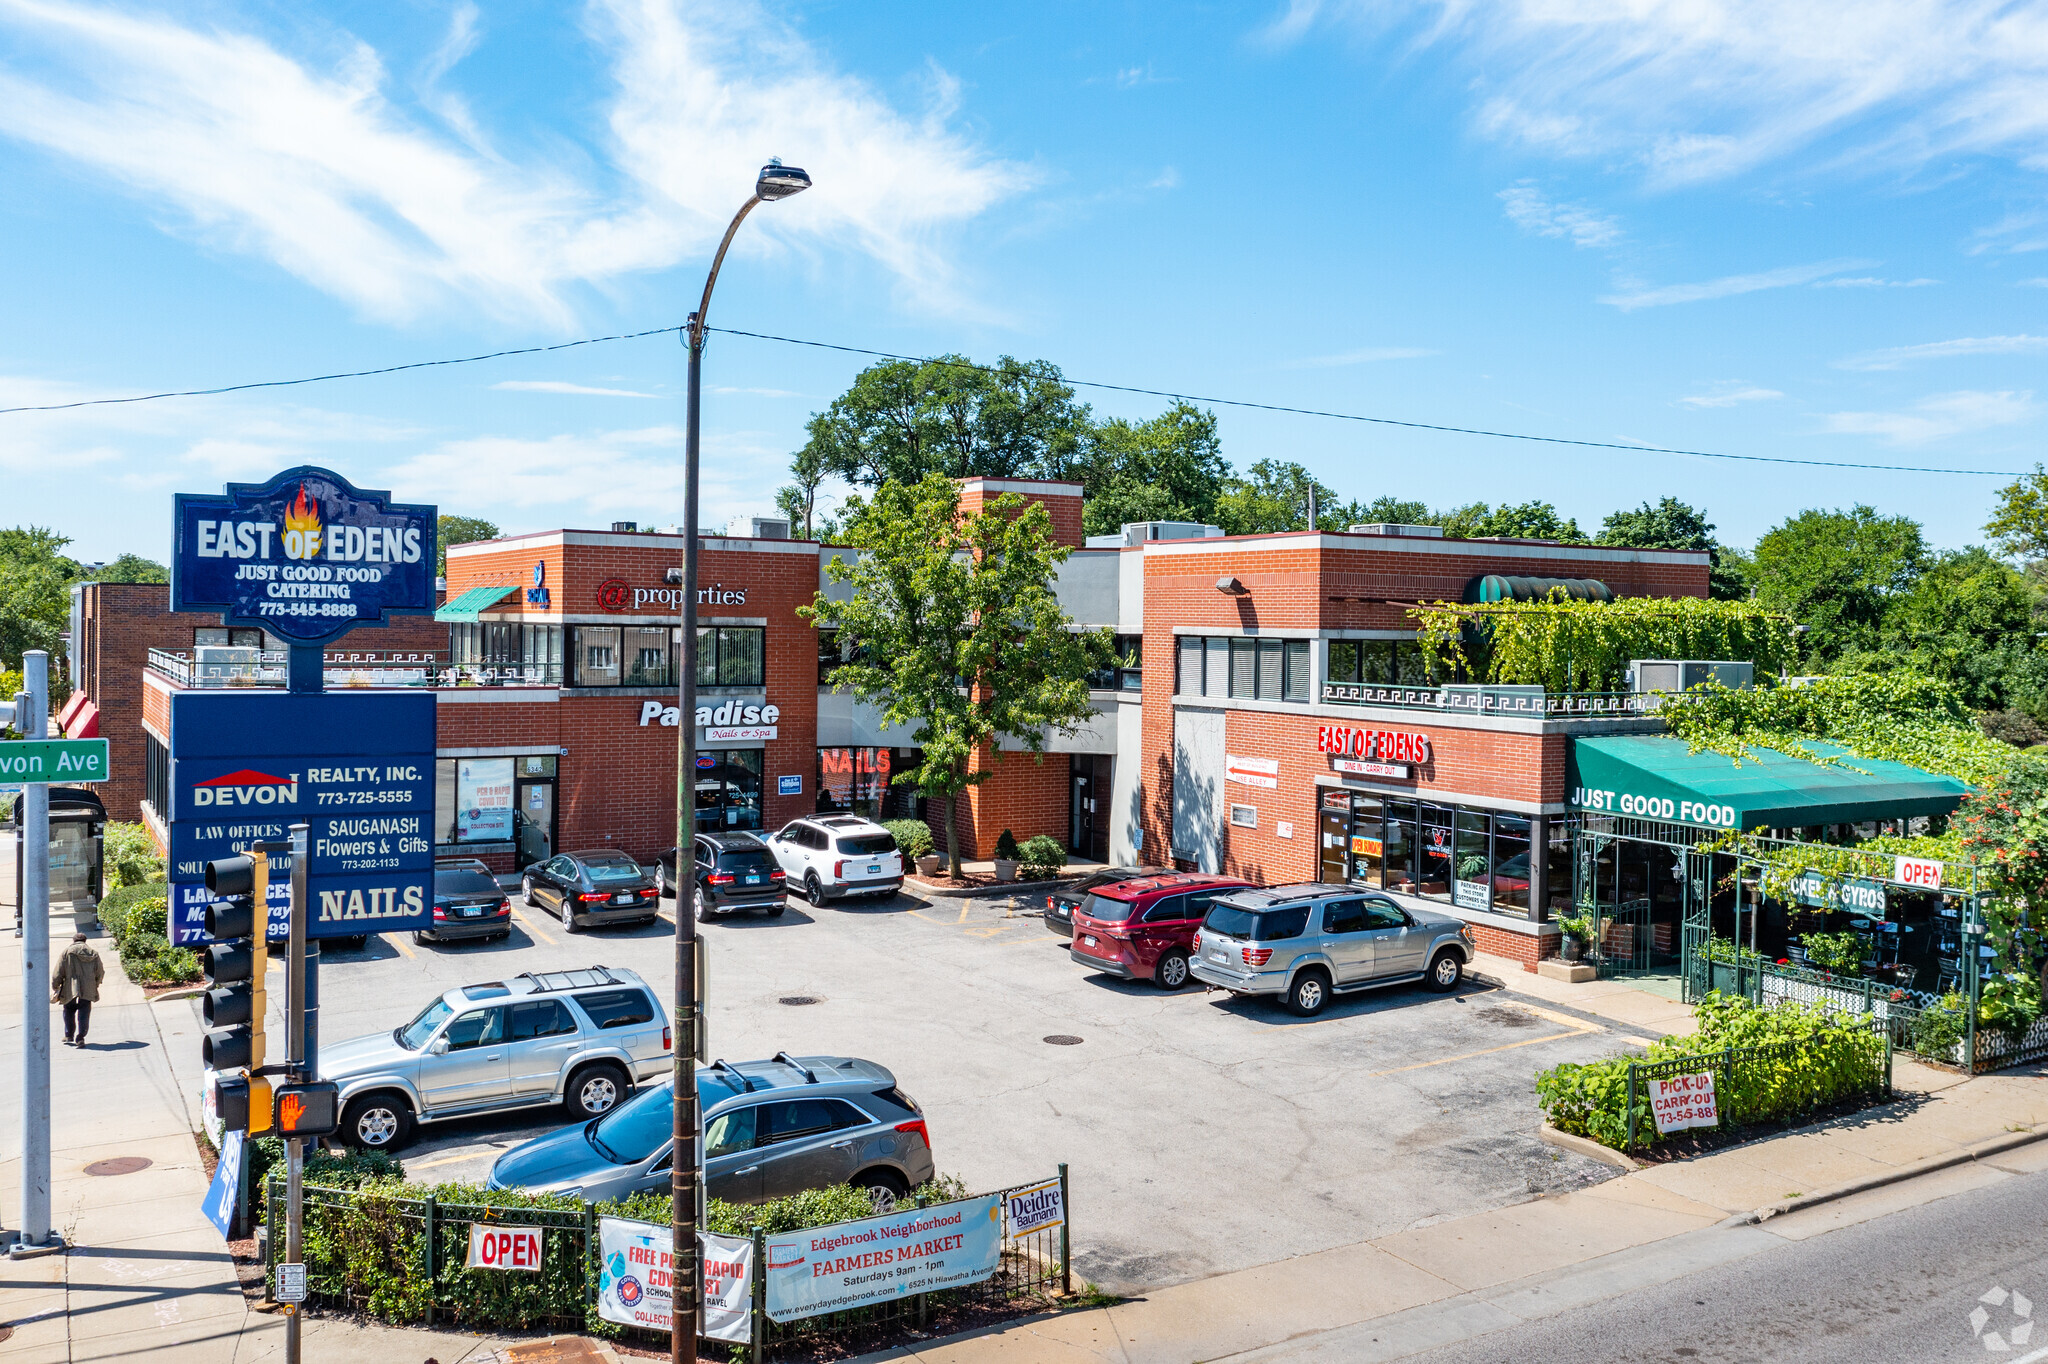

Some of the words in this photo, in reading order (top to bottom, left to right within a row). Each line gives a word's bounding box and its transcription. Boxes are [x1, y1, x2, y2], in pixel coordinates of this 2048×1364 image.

[198, 520, 276, 558] EAST
[284, 530, 319, 560] OF
[328, 525, 421, 563] EDENS
[235, 565, 278, 580] JUST
[282, 566, 331, 582] GOOD
[337, 567, 381, 583] FOOD
[267, 584, 350, 599] CATERING
[597, 579, 748, 612] @proprties
[260, 602, 357, 616] 773-545-8888
[639, 700, 780, 727] Paadise
[712, 730, 738, 739] Nails
[741, 729, 751, 737] &
[752, 729, 771, 739] Spa
[1318, 727, 1351, 754] EAST
[1355, 730, 1373, 757] OF
[1377, 731, 1424, 763] EDENS
[0, 755, 42, 773] von
[56, 751, 99, 771] Ave
[823, 750, 891, 773] NAILS
[1344, 762, 1355, 771] DINE
[1356, 763, 1362, 771] IN
[1366, 765, 1383, 774] CARRY
[1384, 766, 1395, 775] OUT
[307, 767, 379, 784] REALTY,
[386, 766, 422, 781] INC.
[1249, 777, 1266, 785] ALLEY
[194, 774, 299, 806] DEVON
[318, 791, 412, 805] 773-725-5555
[1571, 787, 1615, 810] JUST
[1620, 793, 1675, 818] GOOD
[1681, 801, 1735, 826] FOOD
[195, 826, 224, 840] LAW
[228, 824, 282, 838] OFFICES
[328, 818, 419, 836] SAUGANASH
[232, 841, 248, 853] OF
[316, 838, 375, 857] Flowers
[379, 841, 391, 854] &
[398, 836, 429, 853] Gifts
[342, 858, 399, 870] 773-202-1133
[1903, 862, 1941, 886] OPEN
[1461, 882, 1478, 890] PARKING
[1841, 884, 1885, 909] GYROS
[318, 886, 424, 922] NAILS
[1456, 894, 1480, 903] CUSTOMERS
[1010, 1190, 1059, 1219] Deidre
[1017, 1207, 1057, 1227] Baumann
[811, 1229, 878, 1252] Edgebrook
[880, 1212, 962, 1239] Neighborhood
[482, 1233, 539, 1266] OPEN
[812, 1249, 894, 1278] FARMERS
[897, 1234, 964, 1261] MARKET
[629, 1246, 656, 1266] FREE
[704, 1259, 744, 1279] RAPID
[843, 1270, 893, 1287] Saturdays
[896, 1265, 916, 1276] 9am
[925, 1260, 945, 1271] 1pm
[705, 1279, 721, 1295] ST
[771, 1286, 896, 1317] www.everydayedgebrook.com
[908, 1278, 926, 1289] 6525
[927, 1278, 934, 1286] N
[935, 1271, 969, 1283] Hiawatha
[971, 1265, 994, 1278] Avenue
[705, 1298, 728, 1307] RAVEL
